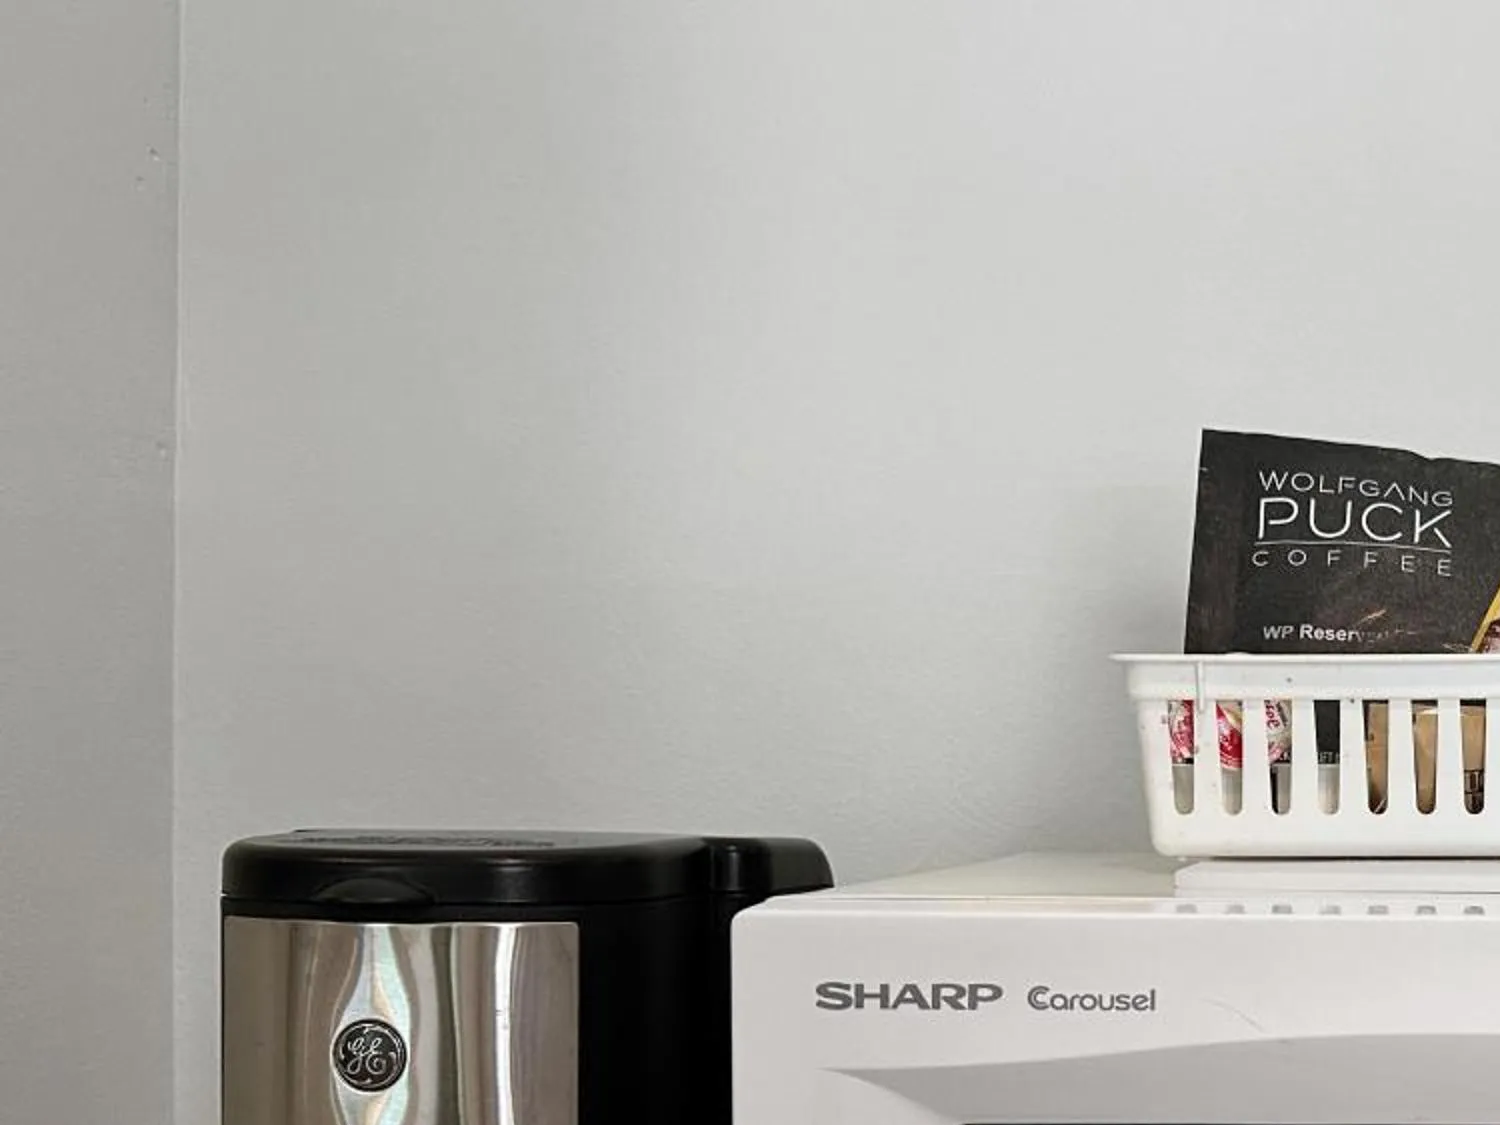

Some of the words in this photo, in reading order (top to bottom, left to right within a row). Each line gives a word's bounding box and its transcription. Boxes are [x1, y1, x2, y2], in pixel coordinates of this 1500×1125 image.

[1258, 471, 1453, 507] WOLFGANG
[1257, 497, 1452, 548] PUCK
[1252, 549, 1453, 577] COFFEE
[1263, 625, 1293, 640] WP
[815, 981, 1004, 1011] SHARP
[1027, 985, 1156, 1012] Carousel
